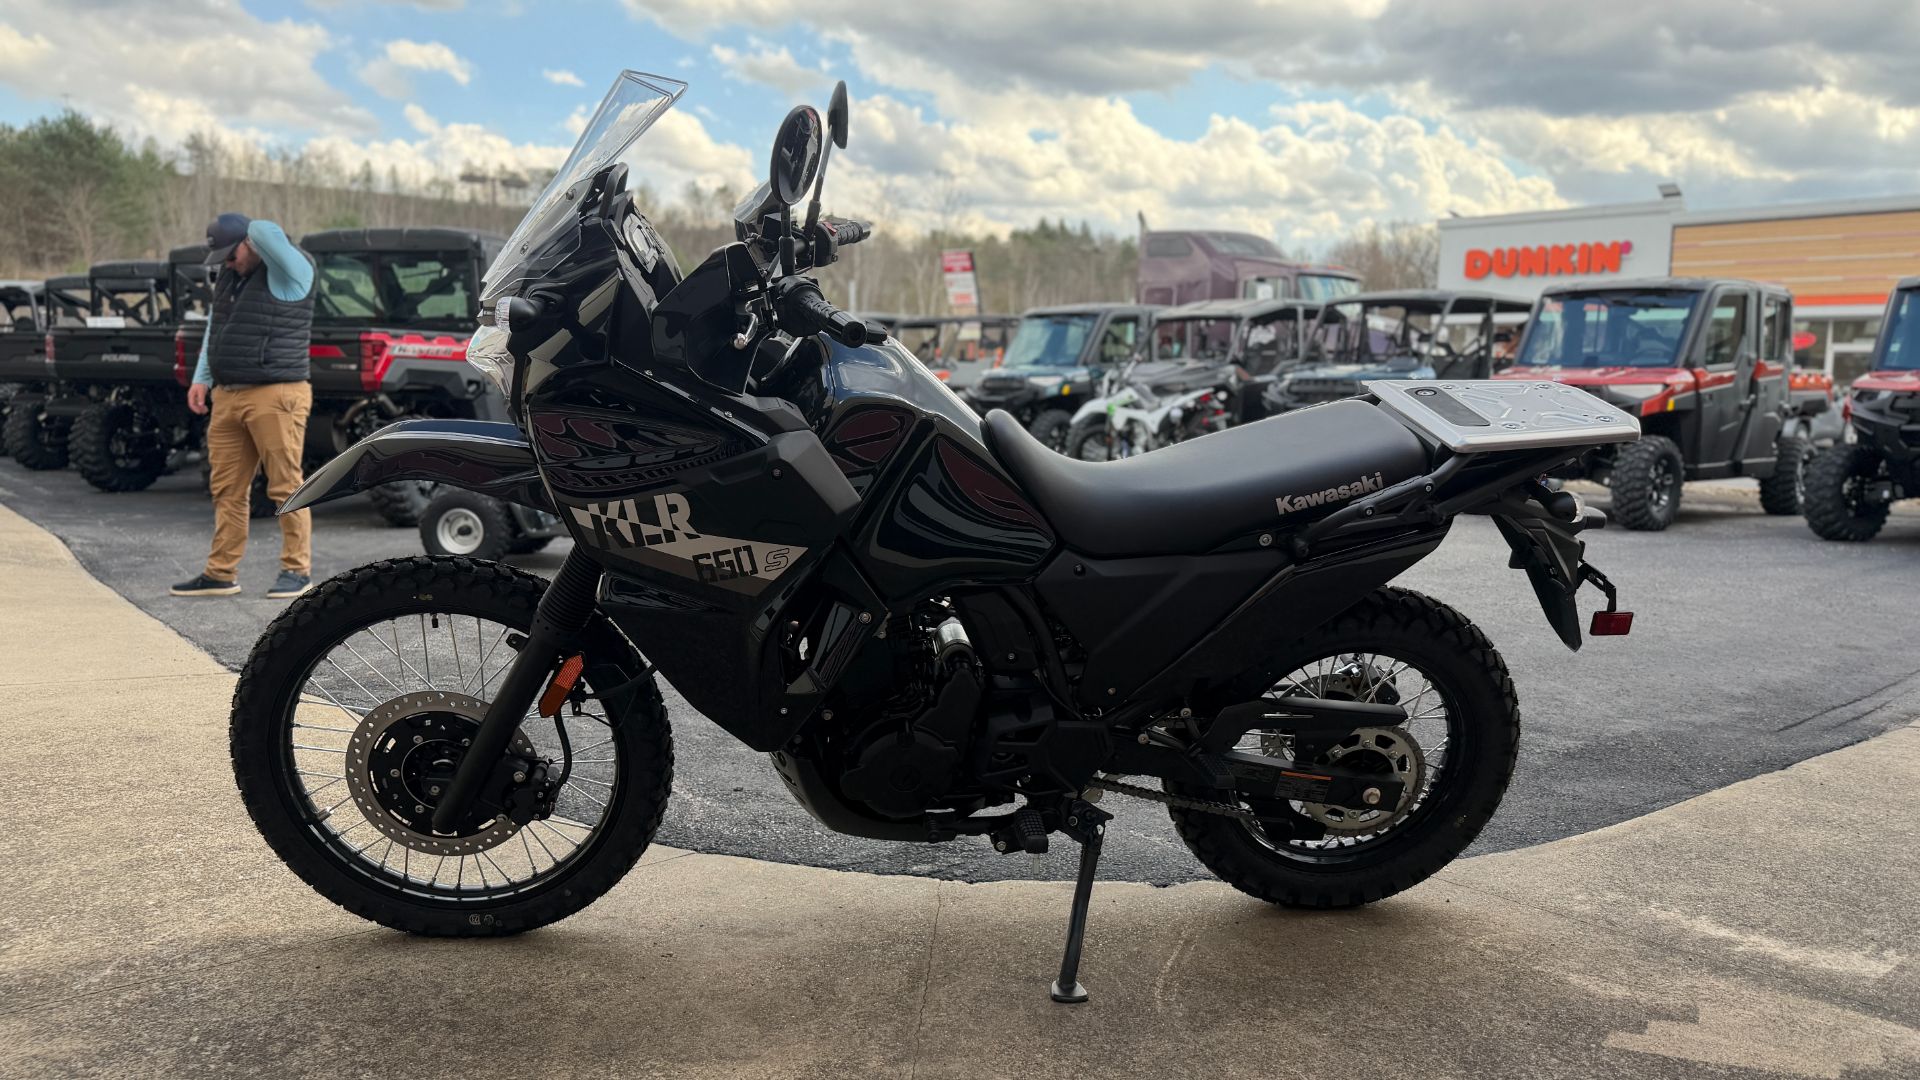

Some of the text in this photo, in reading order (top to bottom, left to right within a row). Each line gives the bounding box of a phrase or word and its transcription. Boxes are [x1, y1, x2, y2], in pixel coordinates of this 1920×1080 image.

[1464, 240, 1632, 280] DUNKIN'
[1275, 471, 1384, 515] Kawasaki
[587, 493, 702, 549] KLR
[692, 545, 790, 584] 650 S
